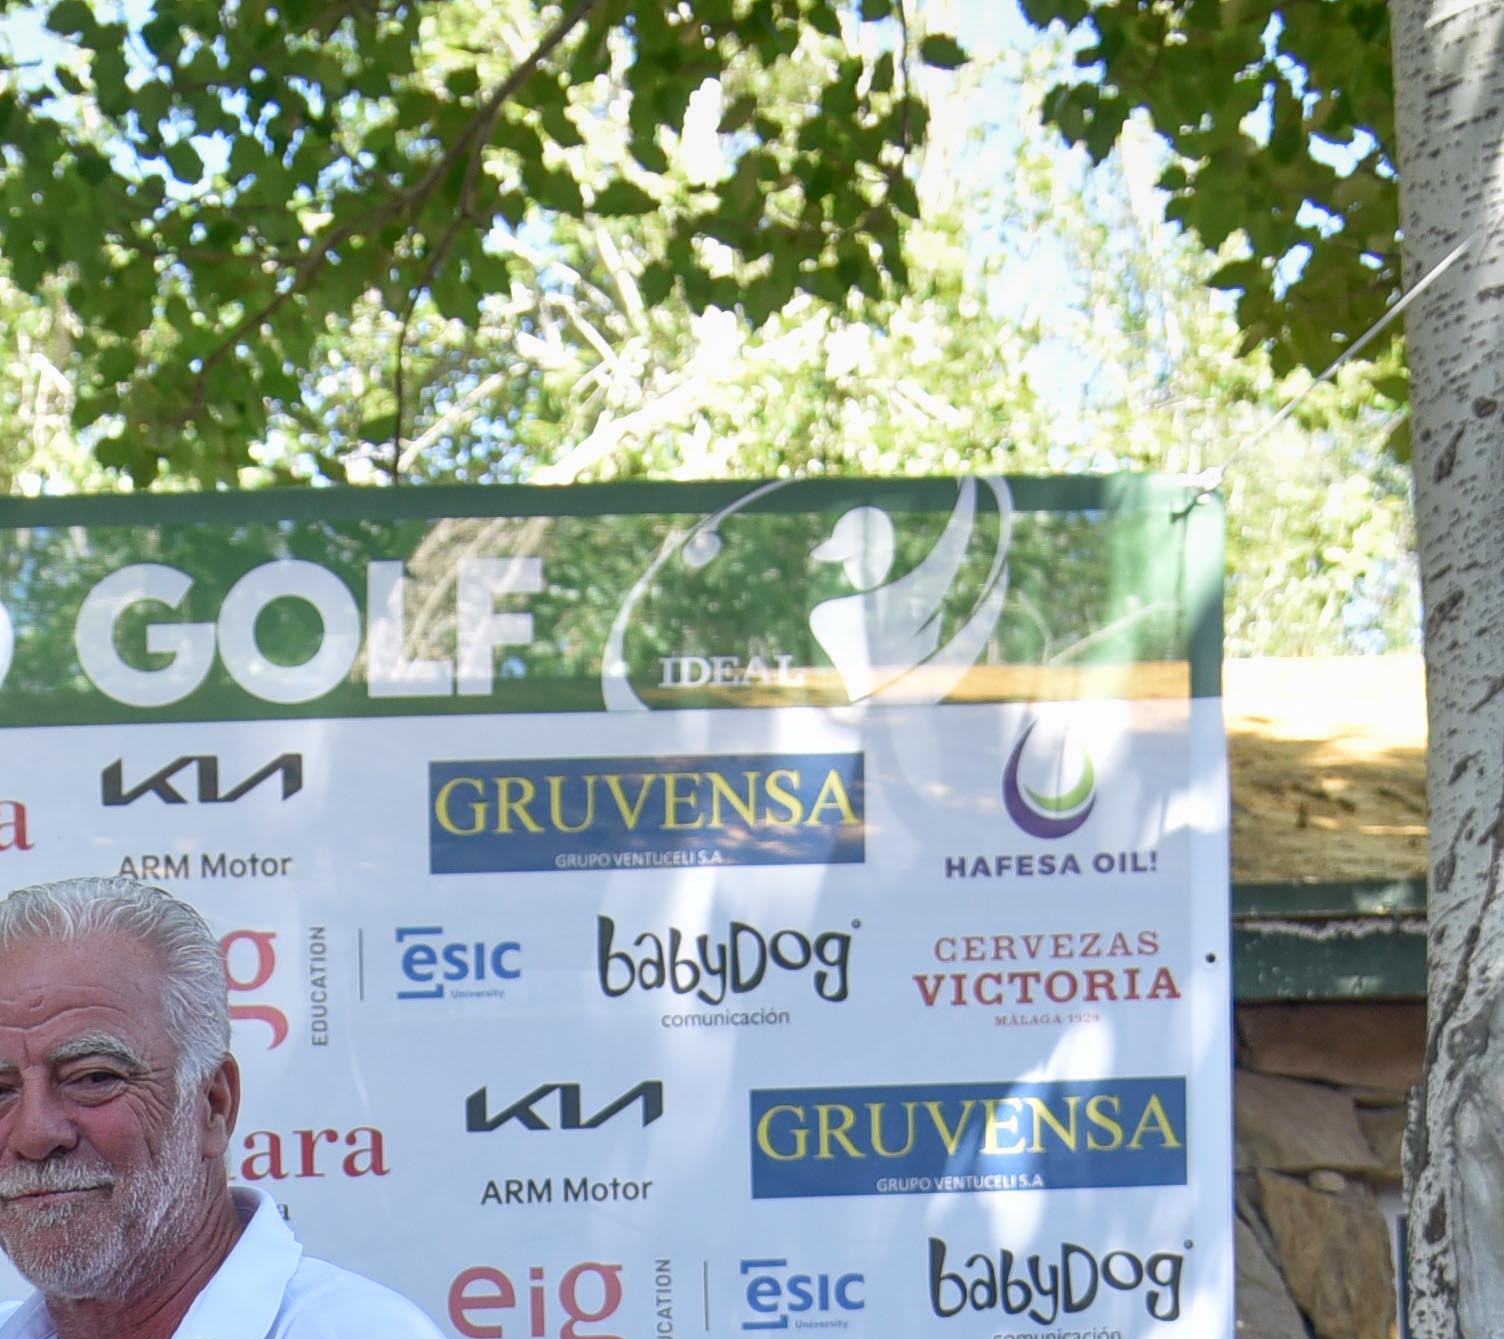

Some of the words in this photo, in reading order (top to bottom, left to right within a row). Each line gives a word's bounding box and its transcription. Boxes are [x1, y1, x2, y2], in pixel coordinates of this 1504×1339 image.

[75, 557, 544, 708] GOLF
[659, 655, 805, 689] IDEAL
[434, 767, 861, 837] GRUVENSA
[118, 855, 190, 881] ARM
[201, 852, 293, 879] Motor
[555, 852, 610, 870] GRUPO
[944, 854, 1081, 881] HAFESA
[1092, 851, 1159, 876] OIL!
[934, 930, 1160, 962] CERVEZAS
[309, 926, 328, 1047] EDUCATION
[913, 967, 1181, 1007] VICTORIA
[661, 1008, 789, 1028] comunicación
[757, 1092, 1183, 1163] GRUVENSA
[228, 1127, 391, 1181] ara
[481, 1179, 553, 1205] ARM
[563, 1177, 653, 1203] Motor
[876, 1176, 931, 1192] GRUPO
